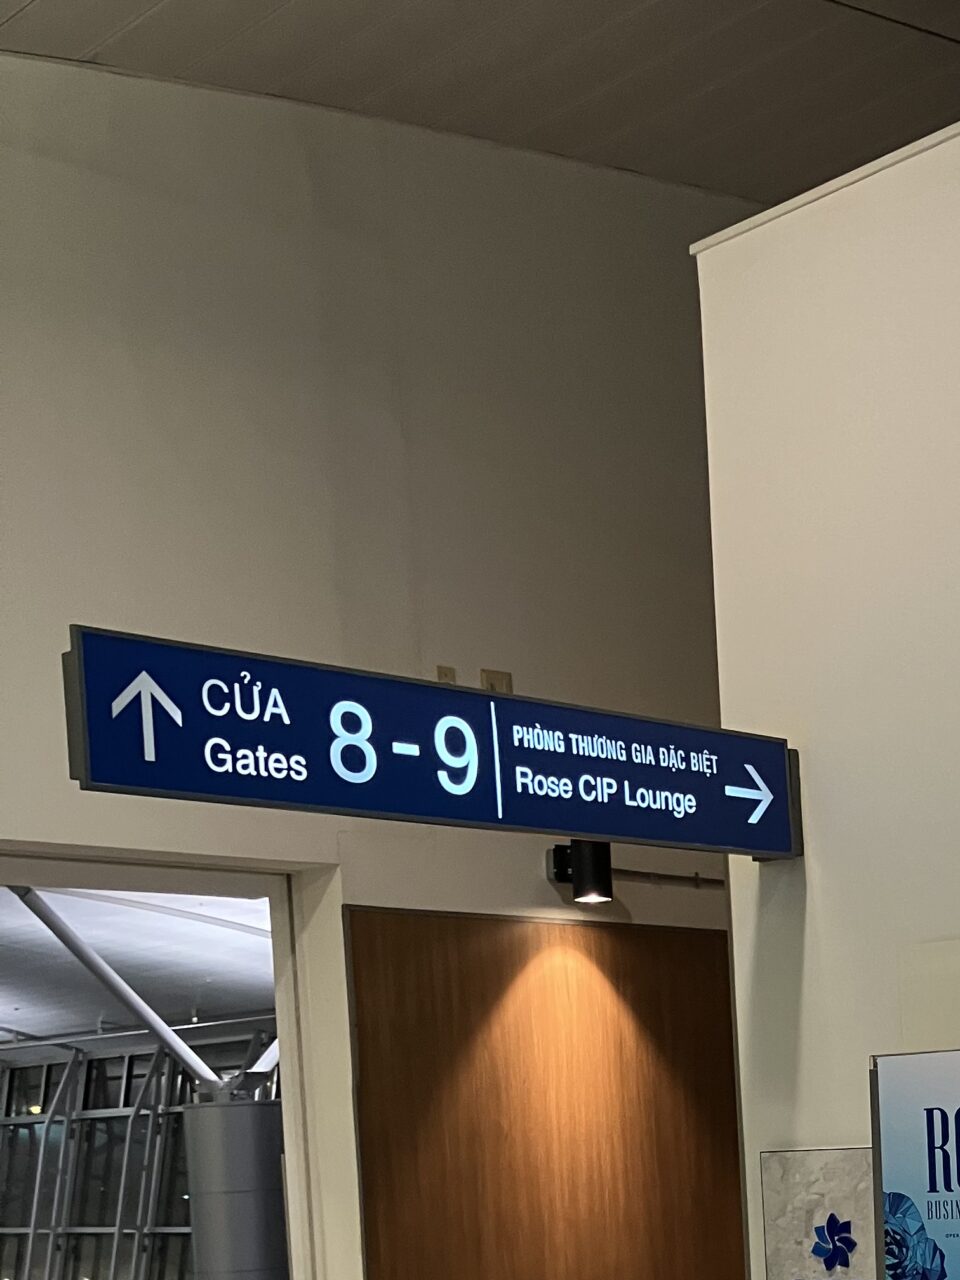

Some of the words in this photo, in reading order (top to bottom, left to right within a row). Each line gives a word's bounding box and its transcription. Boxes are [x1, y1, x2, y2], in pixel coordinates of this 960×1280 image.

[202, 671, 291, 725] CỬA
[204, 737, 308, 781] Gates
[512, 723, 565, 753] PHÒNG
[569, 733, 626, 761] THƯƠNG
[631, 743, 656, 766] GIA
[659, 745, 686, 772] ĐẶC
[690, 749, 718, 777] BIỆT
[515, 766, 573, 799] Rose
[578, 774, 618, 803] CIP
[624, 780, 697, 819] Lounge
